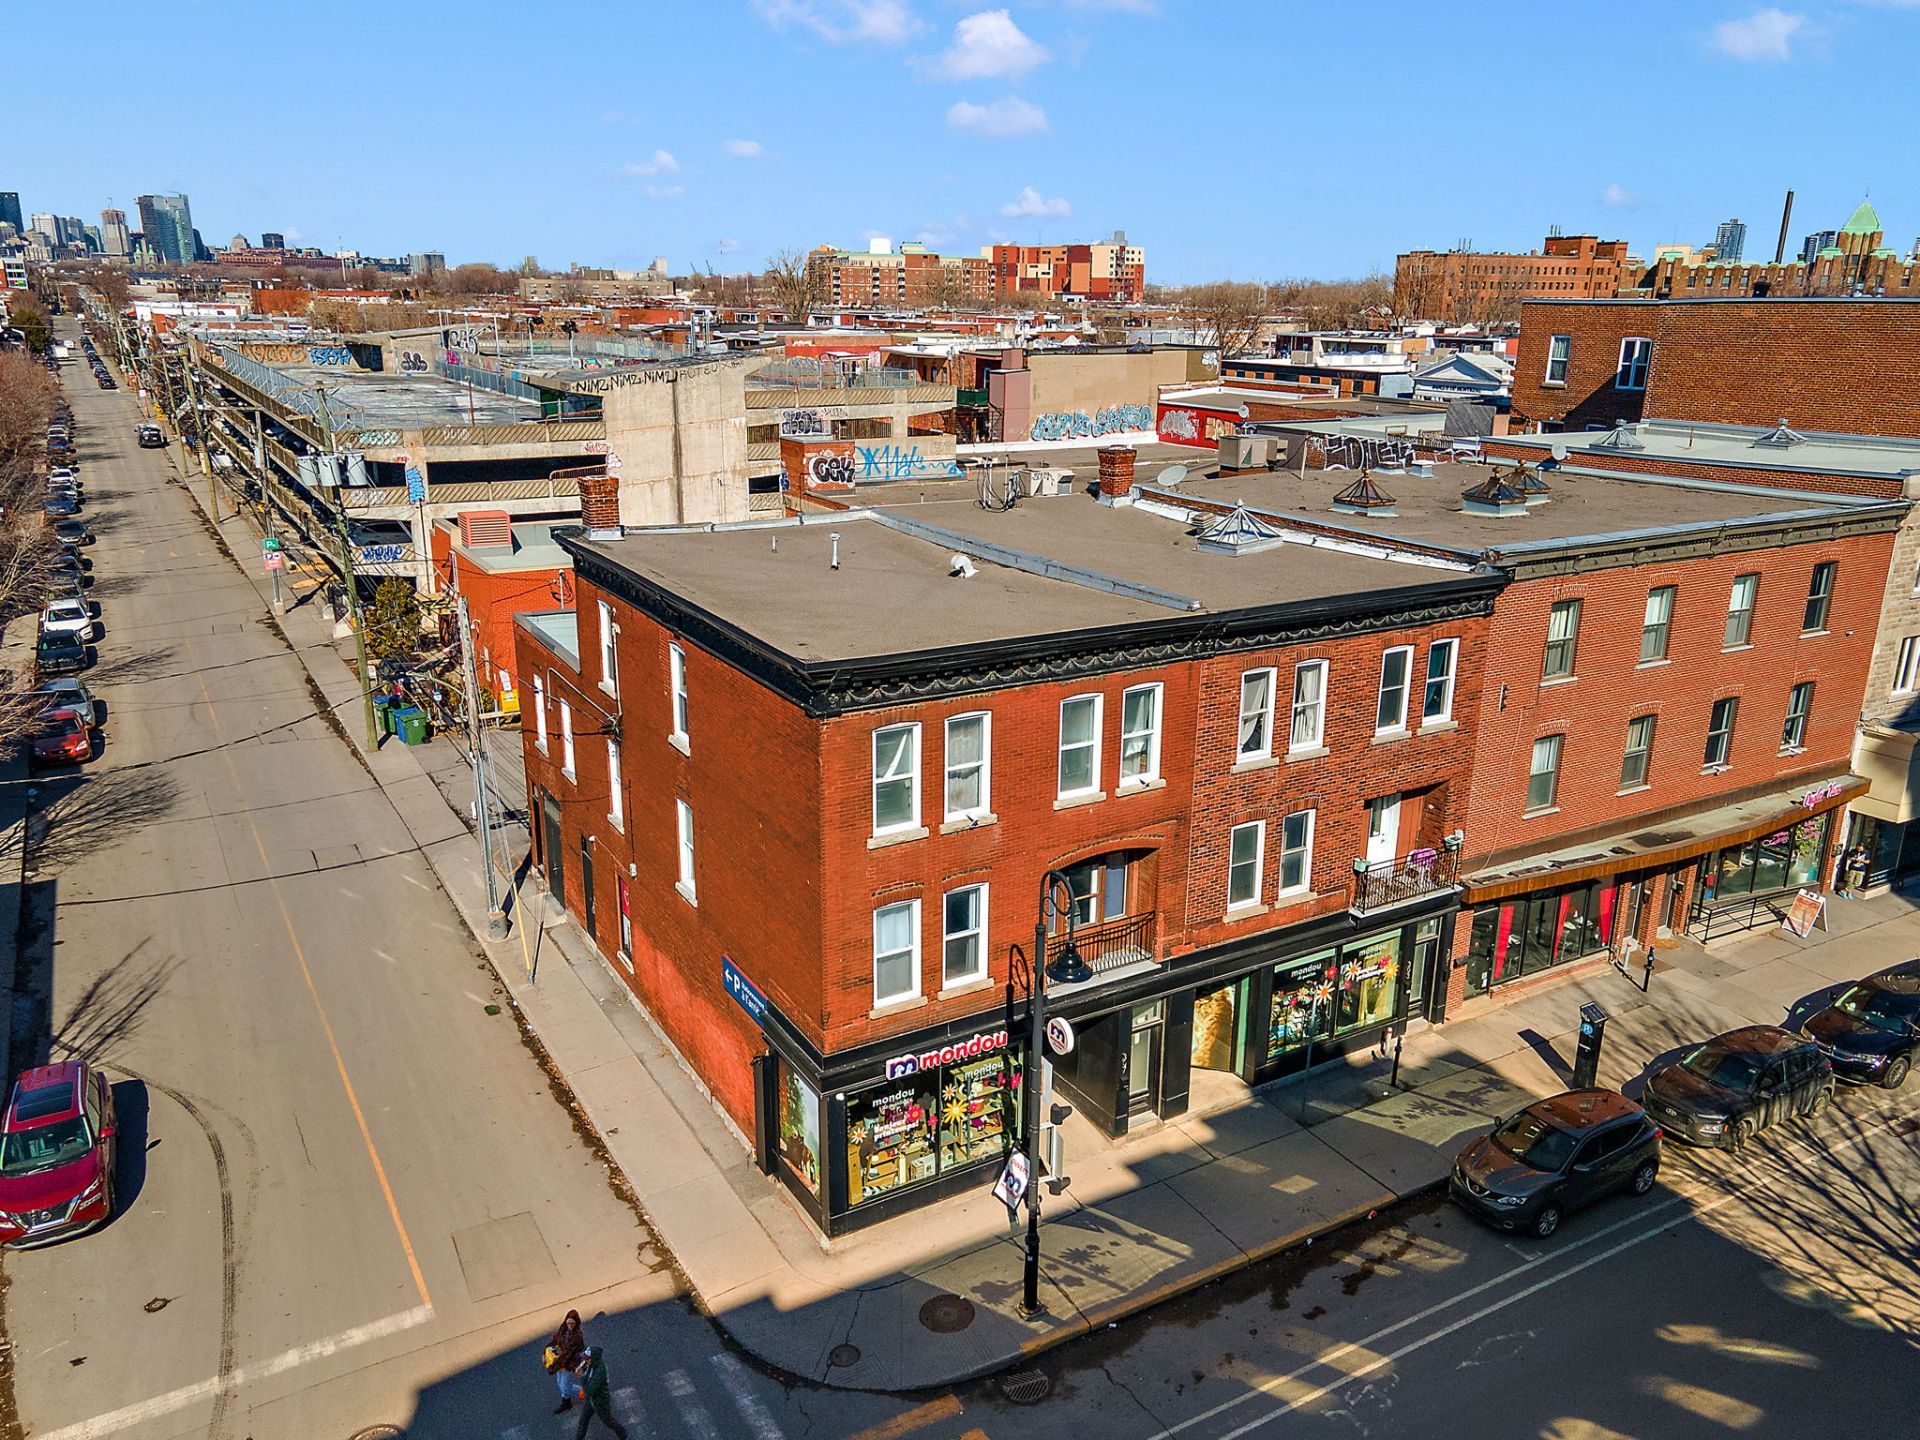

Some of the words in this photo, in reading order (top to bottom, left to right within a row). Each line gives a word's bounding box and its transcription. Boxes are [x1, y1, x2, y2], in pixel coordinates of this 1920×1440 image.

[1292, 962, 1322, 977] mondou
[733, 974, 741, 993] P
[920, 1031, 1008, 1070] mondou
[964, 1060, 1004, 1081] mondou
[872, 1088, 915, 1107] mondou
